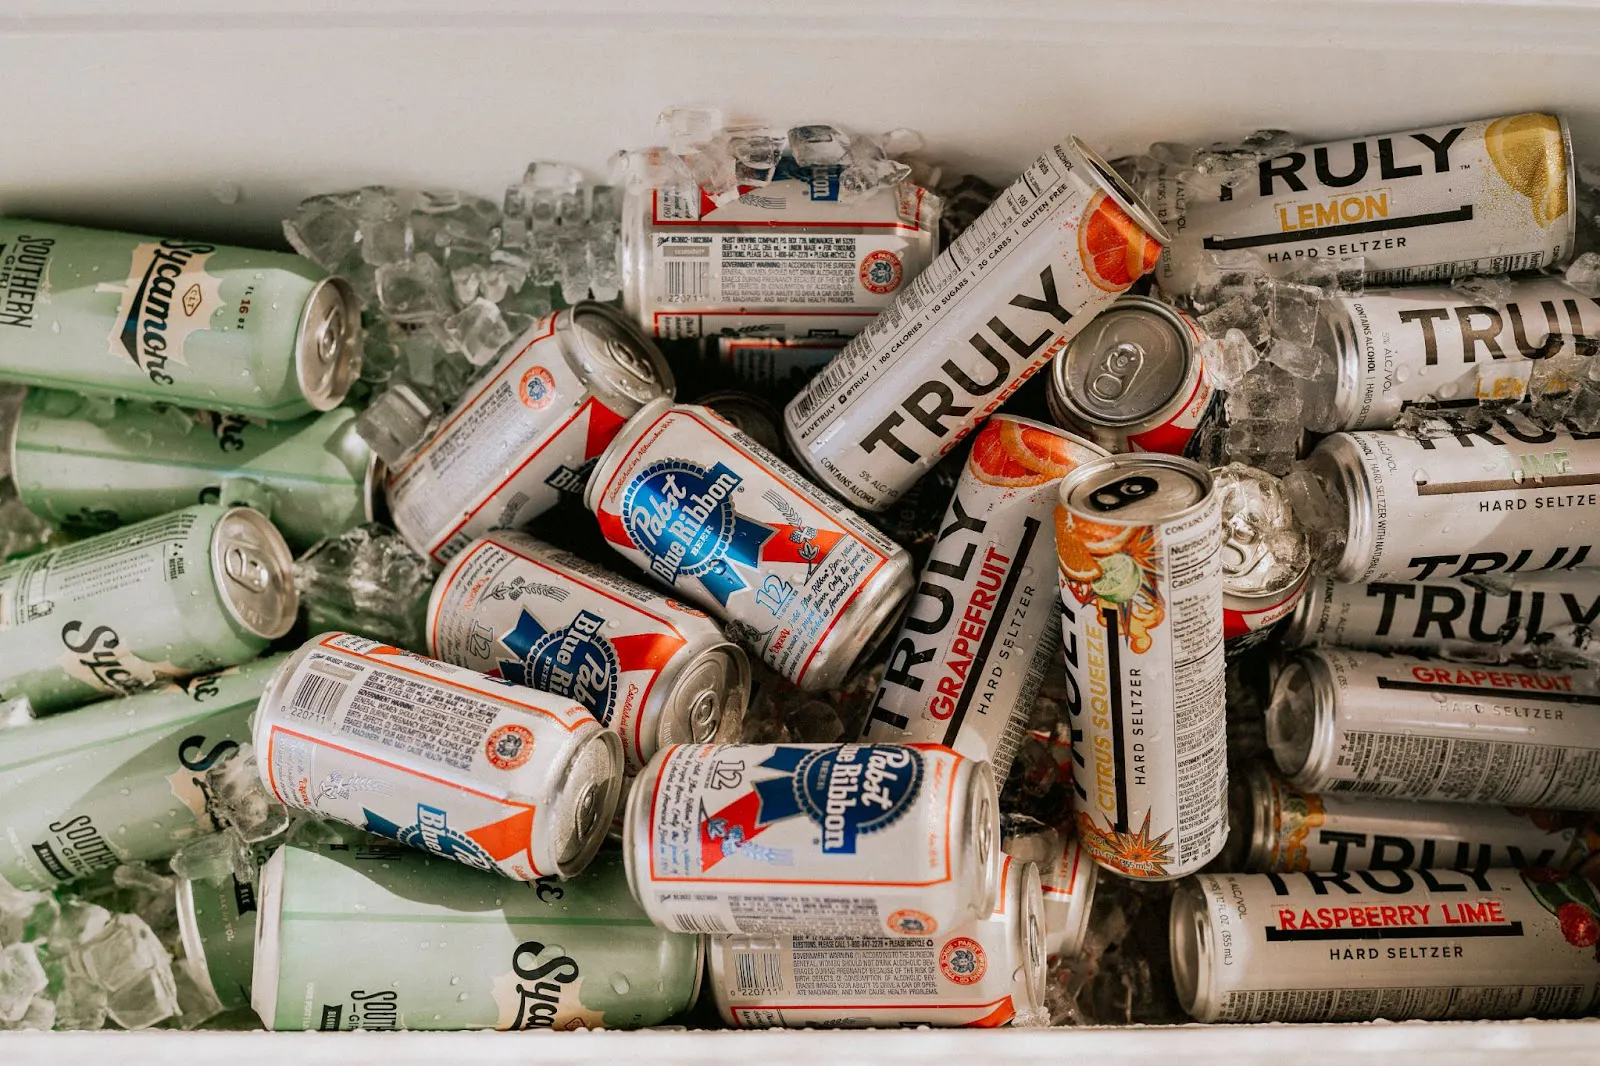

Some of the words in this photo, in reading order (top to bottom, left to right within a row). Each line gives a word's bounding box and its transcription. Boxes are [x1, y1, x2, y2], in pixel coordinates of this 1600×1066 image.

[1219, 127, 1466, 202] RULY
[1280, 192, 1389, 232] LEMON
[1267, 249, 1319, 263] HARD
[1326, 237, 1408, 257] SELTZER
[0, 234, 55, 328] SOUTHERN
[879, 352, 890, 364] 100
[891, 322, 922, 352] CALORIES
[931, 304, 941, 313] 1G
[941, 278, 968, 304] SUGARS
[977, 259, 988, 270] 2G
[988, 236, 1011, 259] CARBS
[1022, 201, 1049, 227] GLUTEN
[1049, 184, 1067, 201] FREE
[120, 239, 217, 386] Sycamore
[239, 299, 251, 314] 16
[1354, 303, 1371, 335] CONTAINS
[859, 265, 1075, 464] TRULY
[1366, 337, 1375, 373] ALCOHOL
[1363, 383, 1374, 403] HARD
[821, 458, 851, 487] CONTAINS
[849, 485, 876, 507] ALCOHOL
[1370, 463, 1382, 484] HARD
[631, 474, 687, 545] Pabst
[669, 473, 739, 547] Ribbon
[1375, 486, 1386, 518] SELTZER
[1479, 498, 1528, 513] HARD
[1535, 494, 1600, 509] SELTZE
[690, 525, 714, 557] BEER
[1376, 520, 1386, 540] WITH
[652, 541, 687, 584] Blue
[1367, 541, 1383, 570] NATURAL
[756, 574, 793, 616] 12
[1171, 572, 1205, 589] Calories
[863, 495, 987, 738] TRULY
[929, 547, 1011, 722] GRAPEFRUIT
[469, 620, 494, 660] 12
[559, 613, 596, 666] Blue
[977, 665, 1004, 715] HARD
[1000, 585, 1036, 660] SELTZER
[358, 689, 389, 701] GOVERNMENT
[574, 653, 611, 706] Pab
[1085, 623, 1109, 731] SQUEEZE
[1412, 666, 1574, 692] GRAPEFRUIT
[369, 708, 388, 719] DURING
[390, 715, 418, 727] PREGNANCY
[378, 703, 396, 713] WOMEN
[398, 709, 417, 719] SHOULD
[1130, 668, 1144, 736] SELTZER
[1492, 704, 1565, 721] SELTZER
[347, 709, 361, 717] BIRTH
[393, 724, 426, 738] CONSUMPTION
[711, 759, 745, 791] 12
[862, 745, 911, 811] Pabst
[1094, 736, 1116, 812] CITRUS
[1134, 745, 1146, 785] HARD
[824, 766, 851, 851] Ribbon
[1278, 904, 1432, 932] RASPBERRY
[1444, 899, 1507, 925] LIME
[1329, 946, 1380, 961] HARD
[1387, 945, 1464, 959] SELTZER
